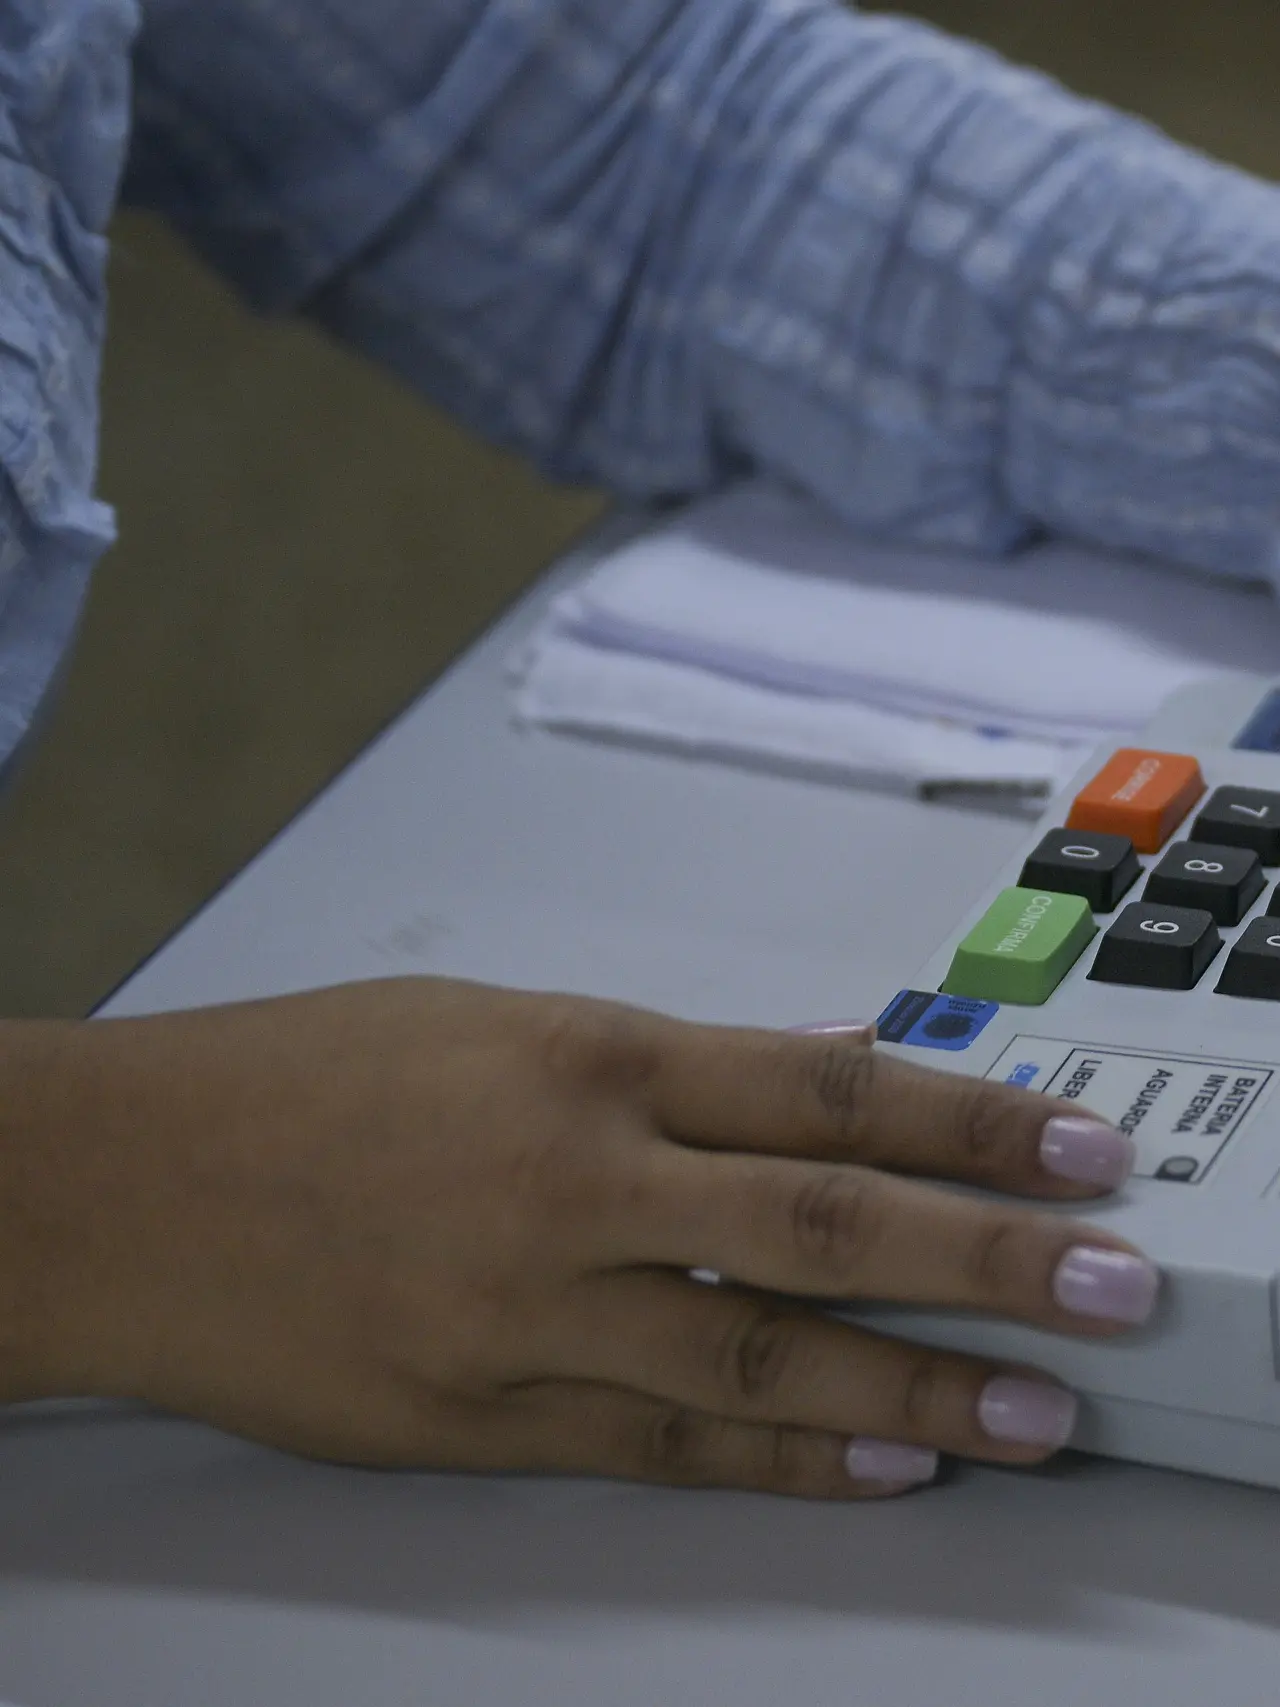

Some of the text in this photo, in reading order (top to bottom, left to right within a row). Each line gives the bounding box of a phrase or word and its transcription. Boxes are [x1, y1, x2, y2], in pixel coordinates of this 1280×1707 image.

[1230, 804, 1269, 819] 7
[1060, 845, 1100, 859] 0
[1184, 859, 1224, 873] 8
[994, 895, 1053, 953] CONFIRMA
[1139, 919, 1180, 935] 9
[1171, 1074, 1229, 1133] INTERNA
[1200, 1077, 1257, 1136] BATERIA
